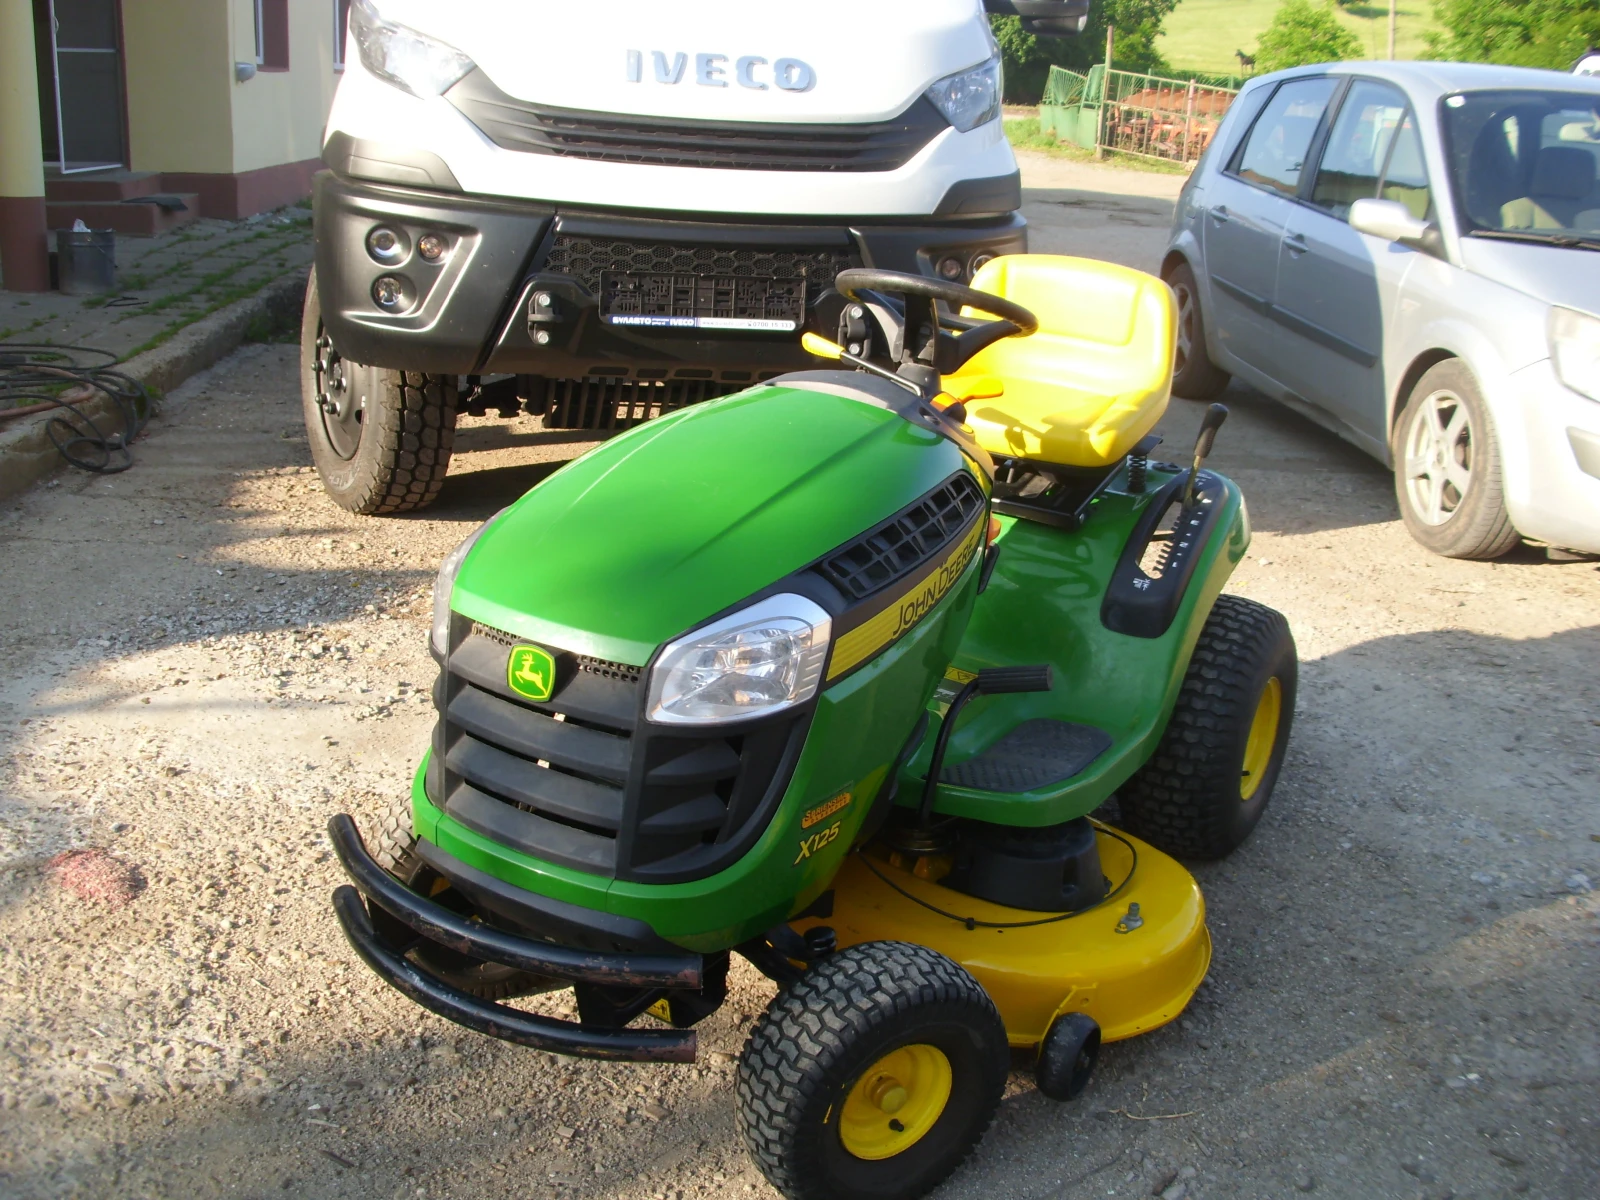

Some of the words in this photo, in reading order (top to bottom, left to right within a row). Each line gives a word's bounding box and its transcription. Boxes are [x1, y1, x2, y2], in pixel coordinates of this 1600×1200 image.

[626, 49, 817, 93] IVECO
[893, 581, 937, 636] JOHN
[938, 534, 975, 595] DEERE
[793, 820, 841, 866] X125
